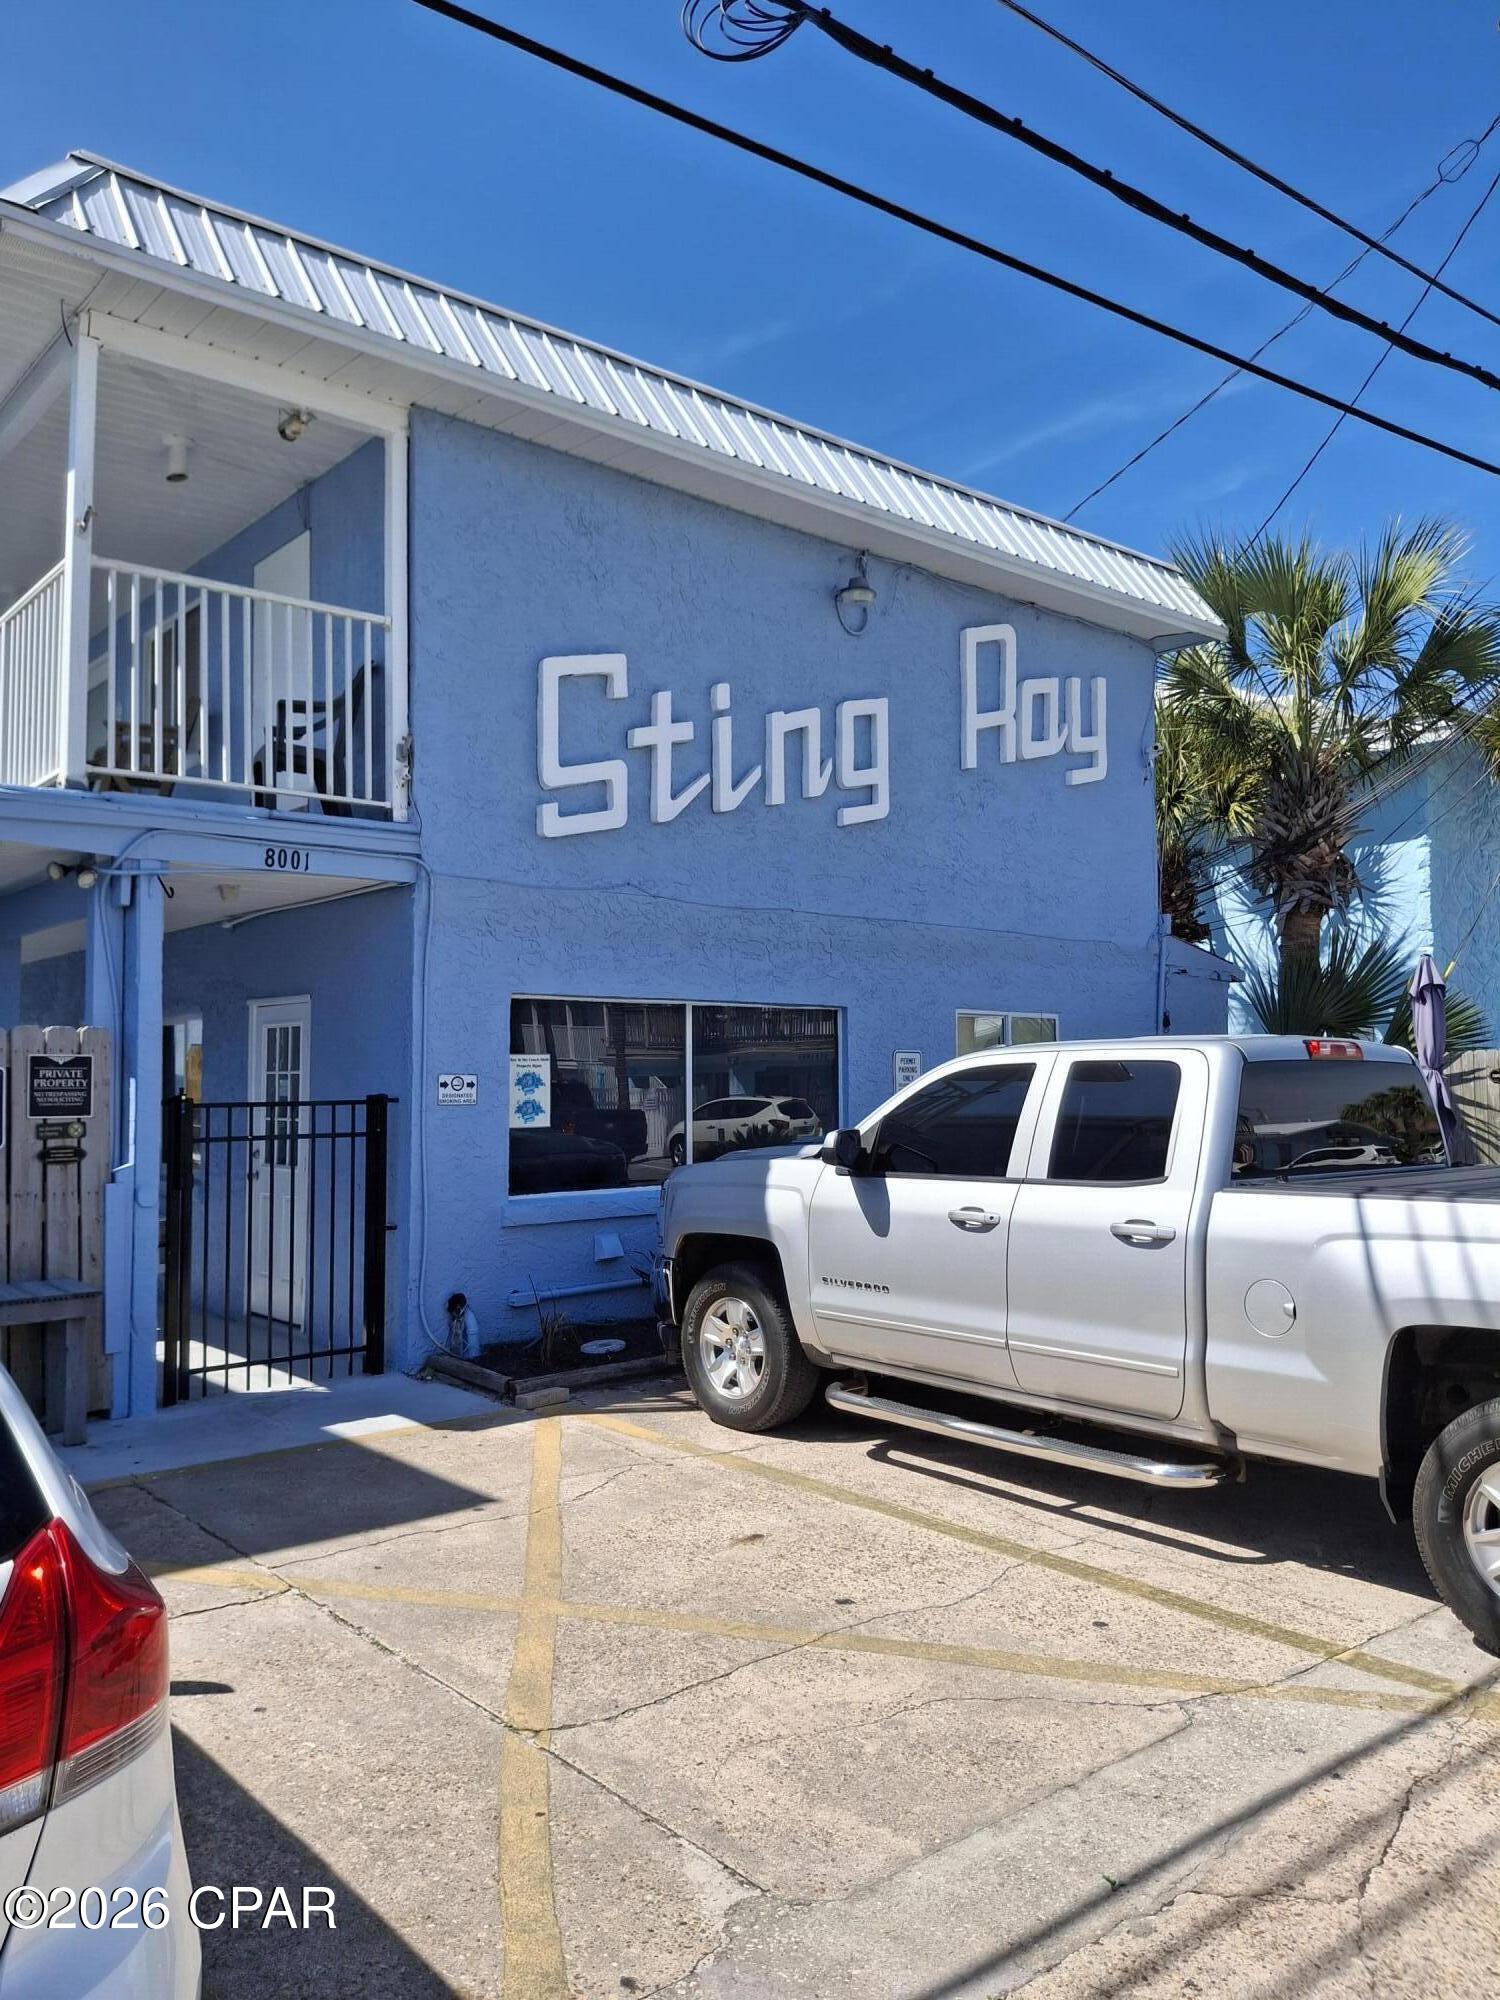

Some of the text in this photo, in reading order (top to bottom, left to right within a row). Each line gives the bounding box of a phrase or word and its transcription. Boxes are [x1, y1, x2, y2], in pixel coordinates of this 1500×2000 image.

[536, 623, 1107, 838] Sting Ray
[265, 848, 309, 872] 8001
[33, 1078, 87, 1087] PROPERTY
[39, 1069, 83, 1078] PRIVATE
[822, 1276, 890, 1294] SILVERADO
